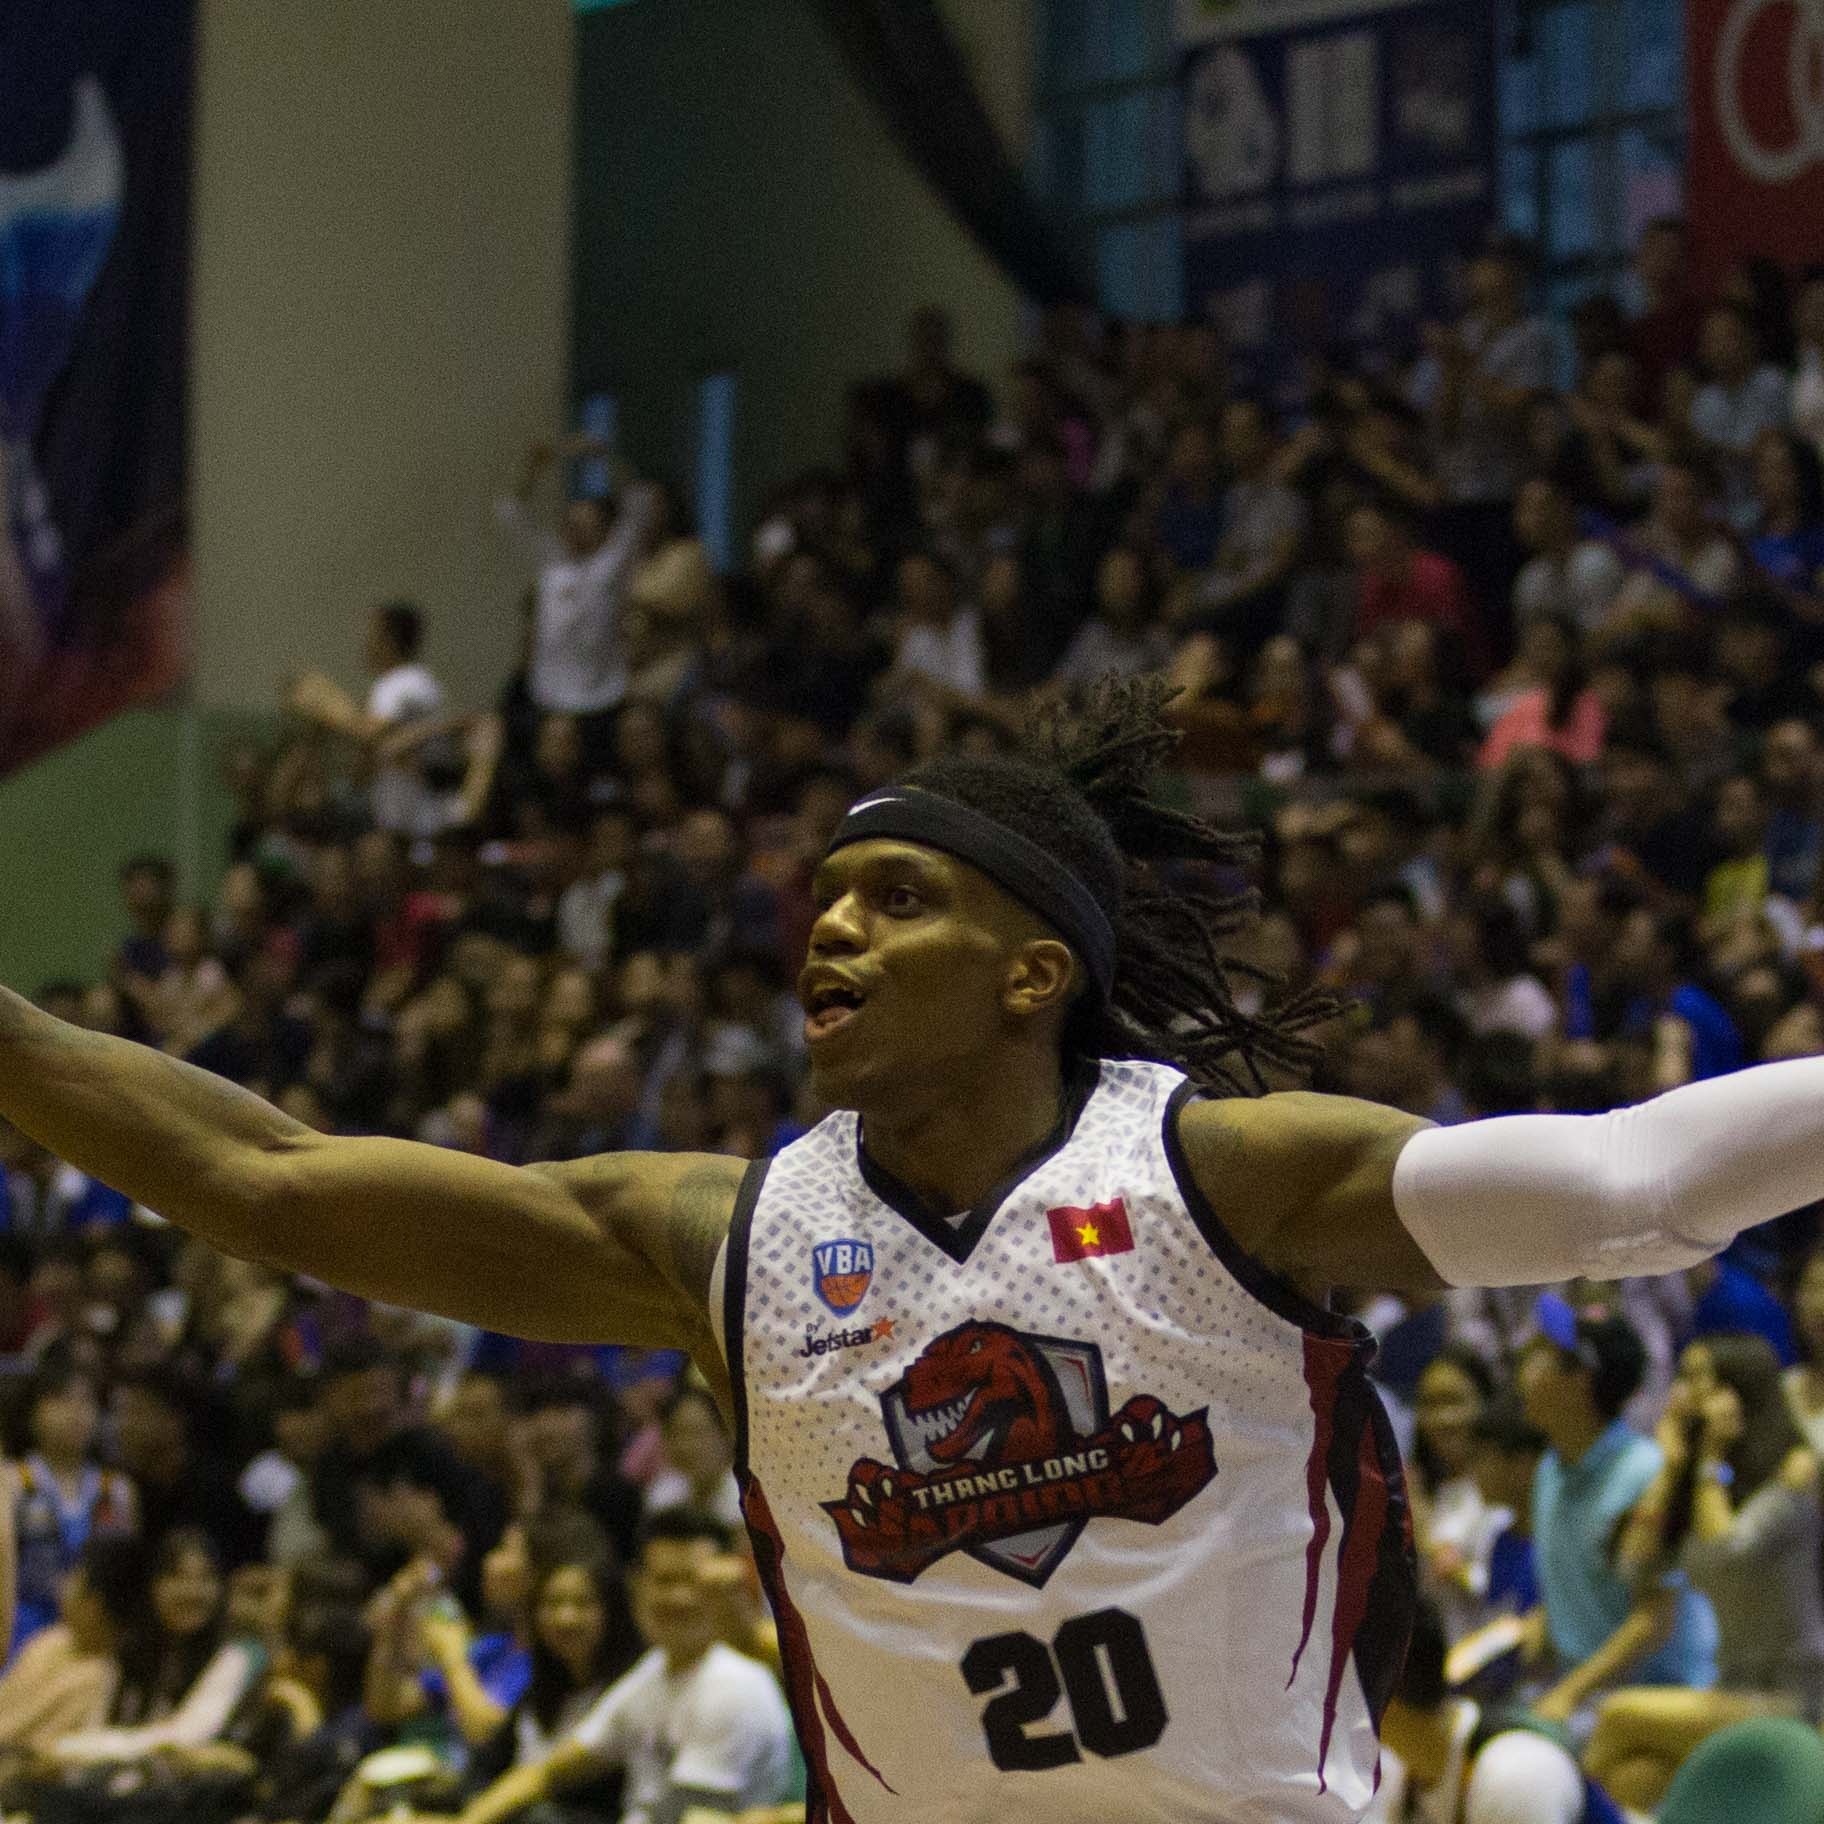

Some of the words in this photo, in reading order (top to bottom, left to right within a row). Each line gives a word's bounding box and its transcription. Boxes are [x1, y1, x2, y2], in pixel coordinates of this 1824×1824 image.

[816, 1244, 872, 1276] VBA
[799, 1328, 873, 1357] Jetstar
[912, 1468, 1018, 1511] THANG
[1025, 1448, 1110, 1485] LONG
[960, 1607, 1170, 1772] 20
